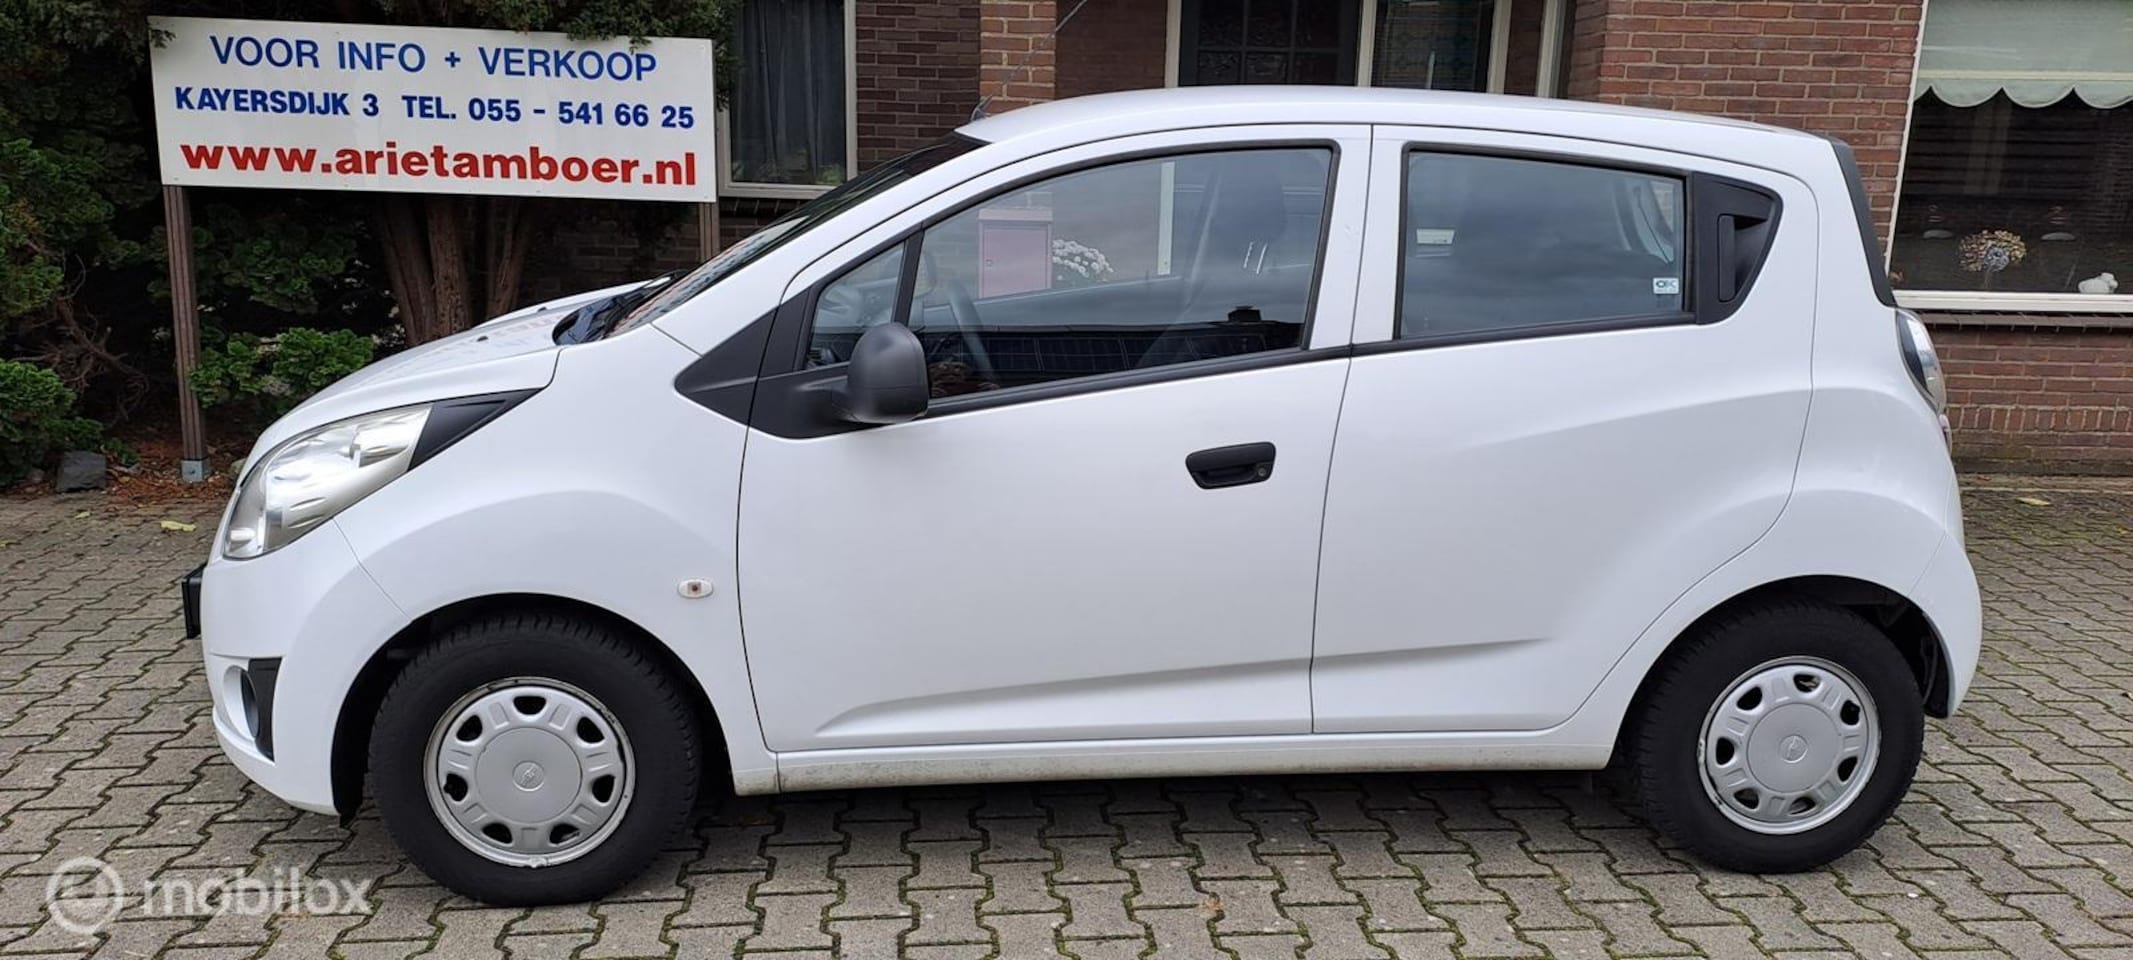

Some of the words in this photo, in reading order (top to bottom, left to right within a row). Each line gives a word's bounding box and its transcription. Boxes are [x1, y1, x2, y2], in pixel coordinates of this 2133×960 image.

[210, 36, 320, 68] VOOR
[338, 41, 426, 73] INFO
[445, 52, 461, 67] +
[478, 47, 657, 81] VERKOOP
[175, 87, 349, 115] KAYERSDIJK
[363, 94, 379, 117] 3
[402, 95, 456, 119] TEL.
[468, 98, 521, 122] 055
[558, 102, 603, 125] 541
[614, 104, 649, 127] 66
[661, 106, 694, 129] 25
[180, 142, 696, 186] www.arietamboer.nl
